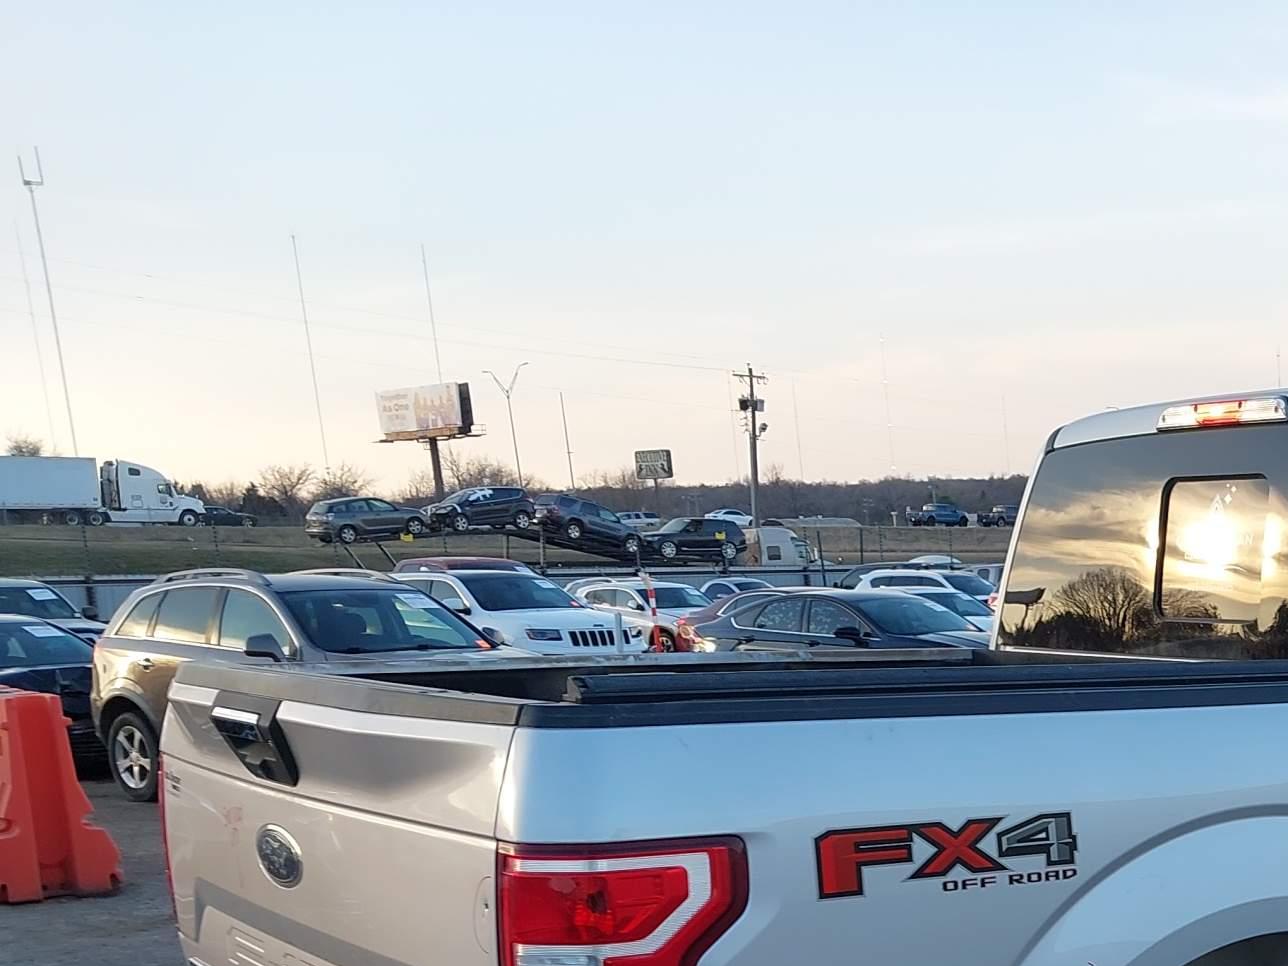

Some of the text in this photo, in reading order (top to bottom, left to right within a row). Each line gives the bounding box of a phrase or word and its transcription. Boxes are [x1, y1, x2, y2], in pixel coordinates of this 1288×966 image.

[815, 812, 1078, 900] FX4
[942, 868, 1078, 892] OFF ROAD
